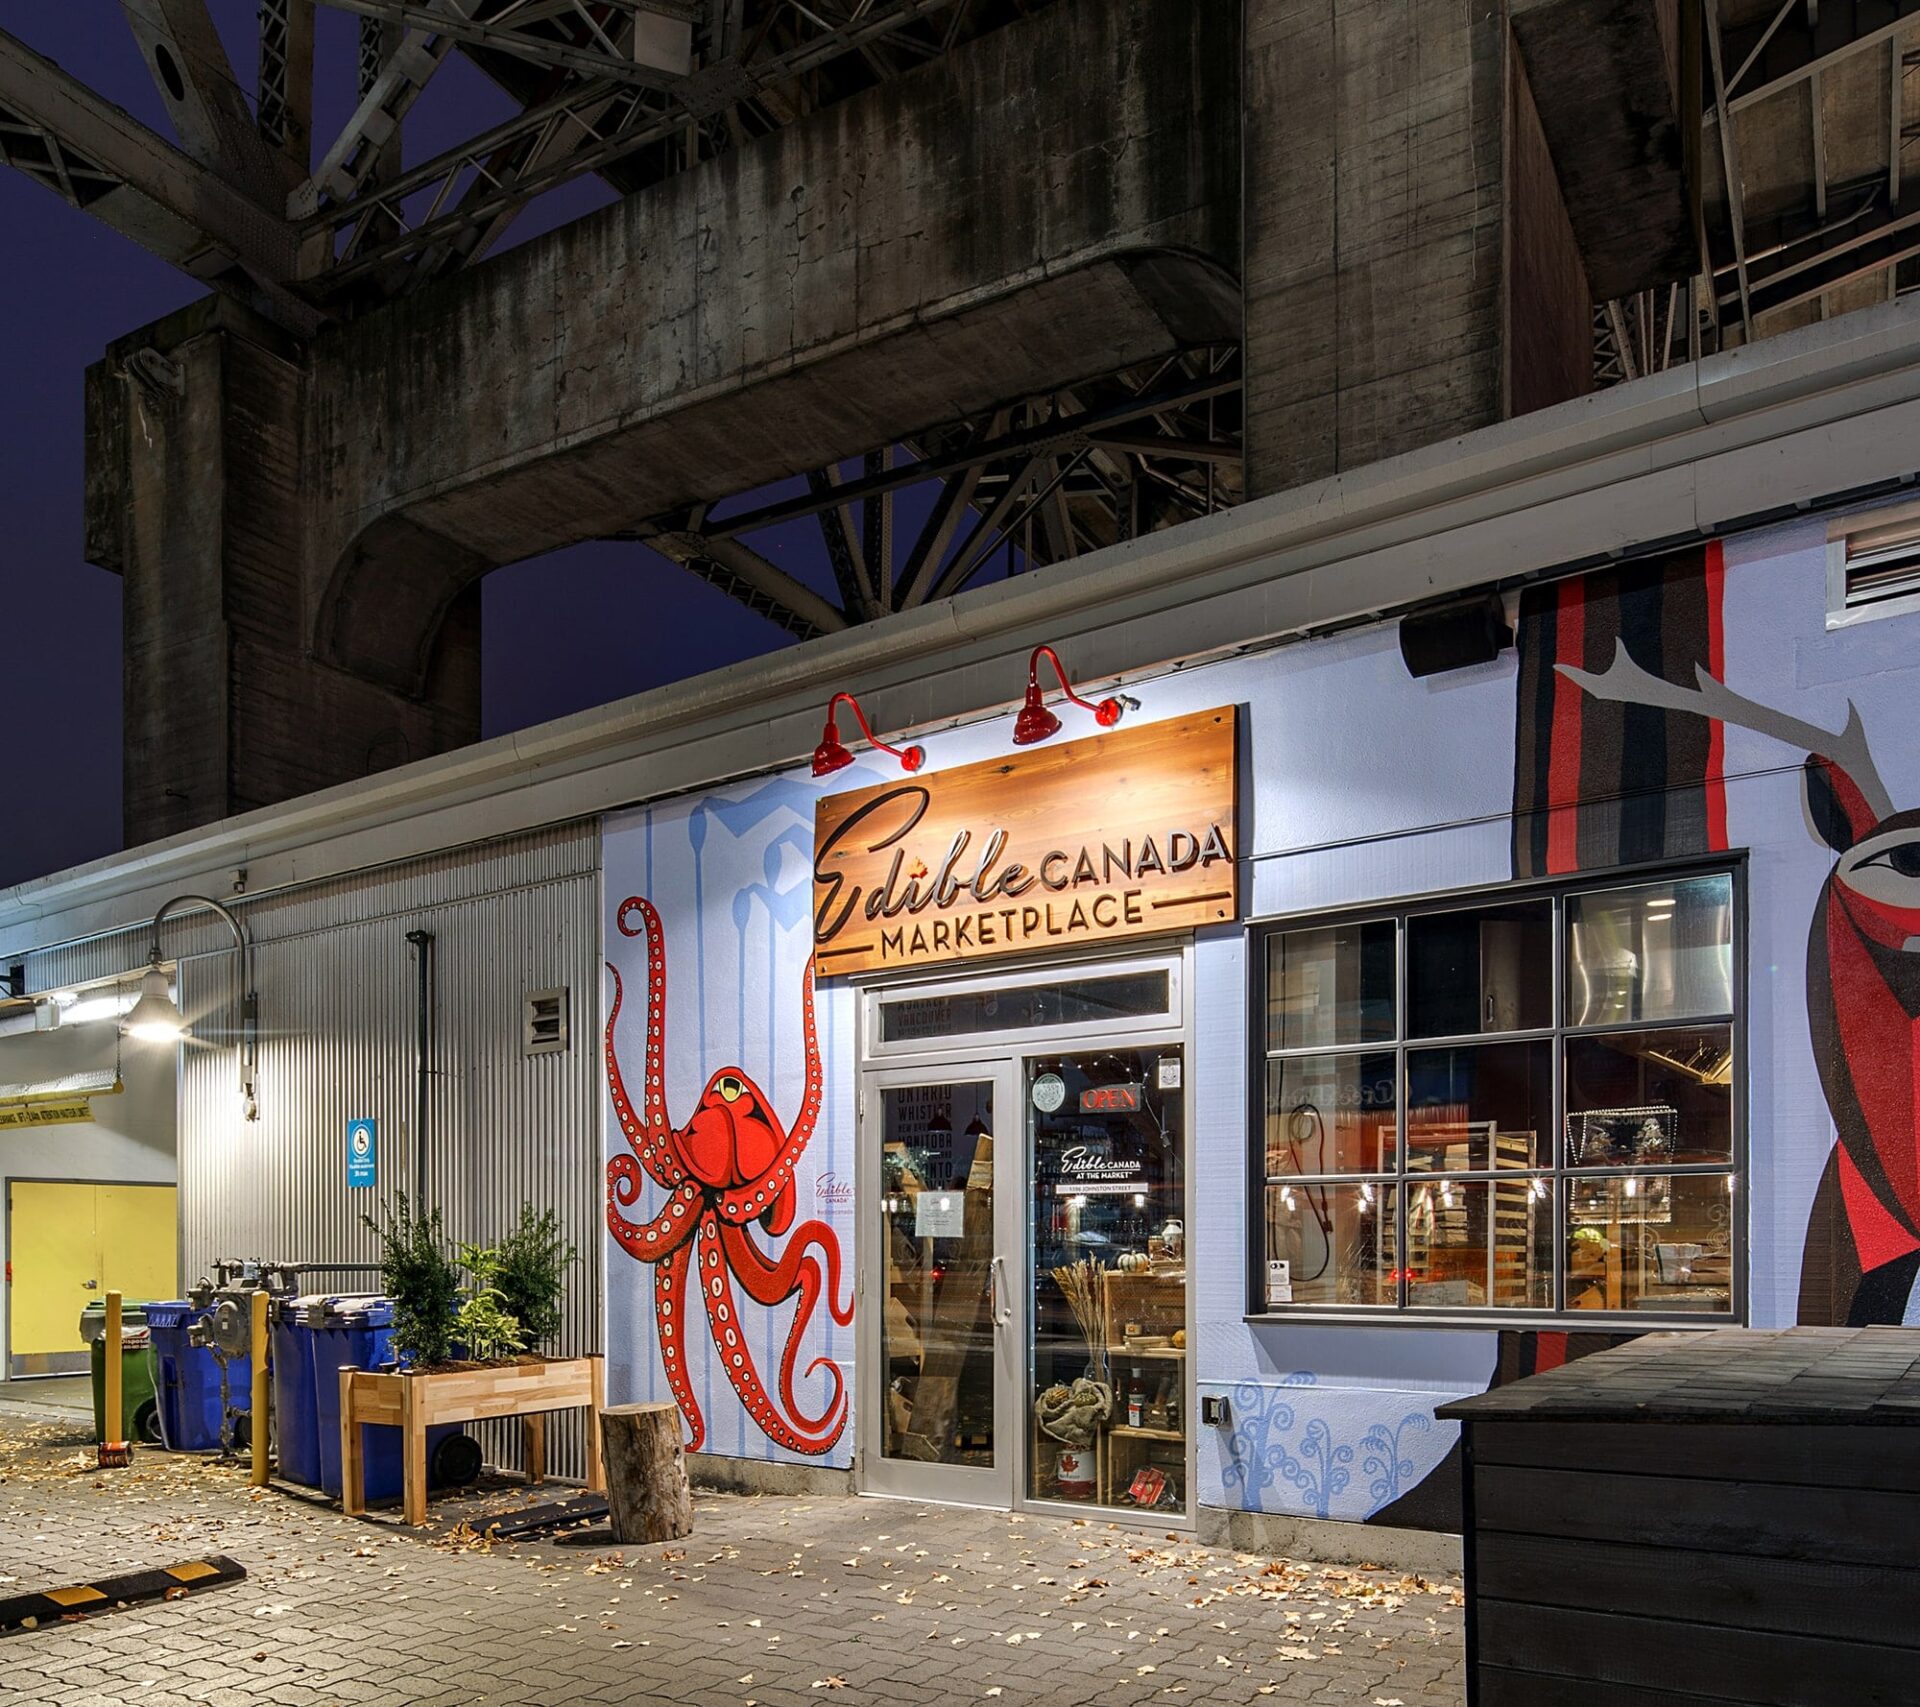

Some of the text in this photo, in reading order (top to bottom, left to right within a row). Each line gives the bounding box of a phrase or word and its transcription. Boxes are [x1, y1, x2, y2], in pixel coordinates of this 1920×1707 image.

[814, 786, 1234, 944] Edible CANADA
[880, 889, 1144, 960] MARKETPLACE
[1081, 1088, 1137, 1110] OPEN
[1061, 1146, 1141, 1173] Edible CANADA
[816, 1171, 852, 1198] Edible
[1076, 1172, 1085, 1180] AT
[1086, 1172, 1100, 1180] THE
